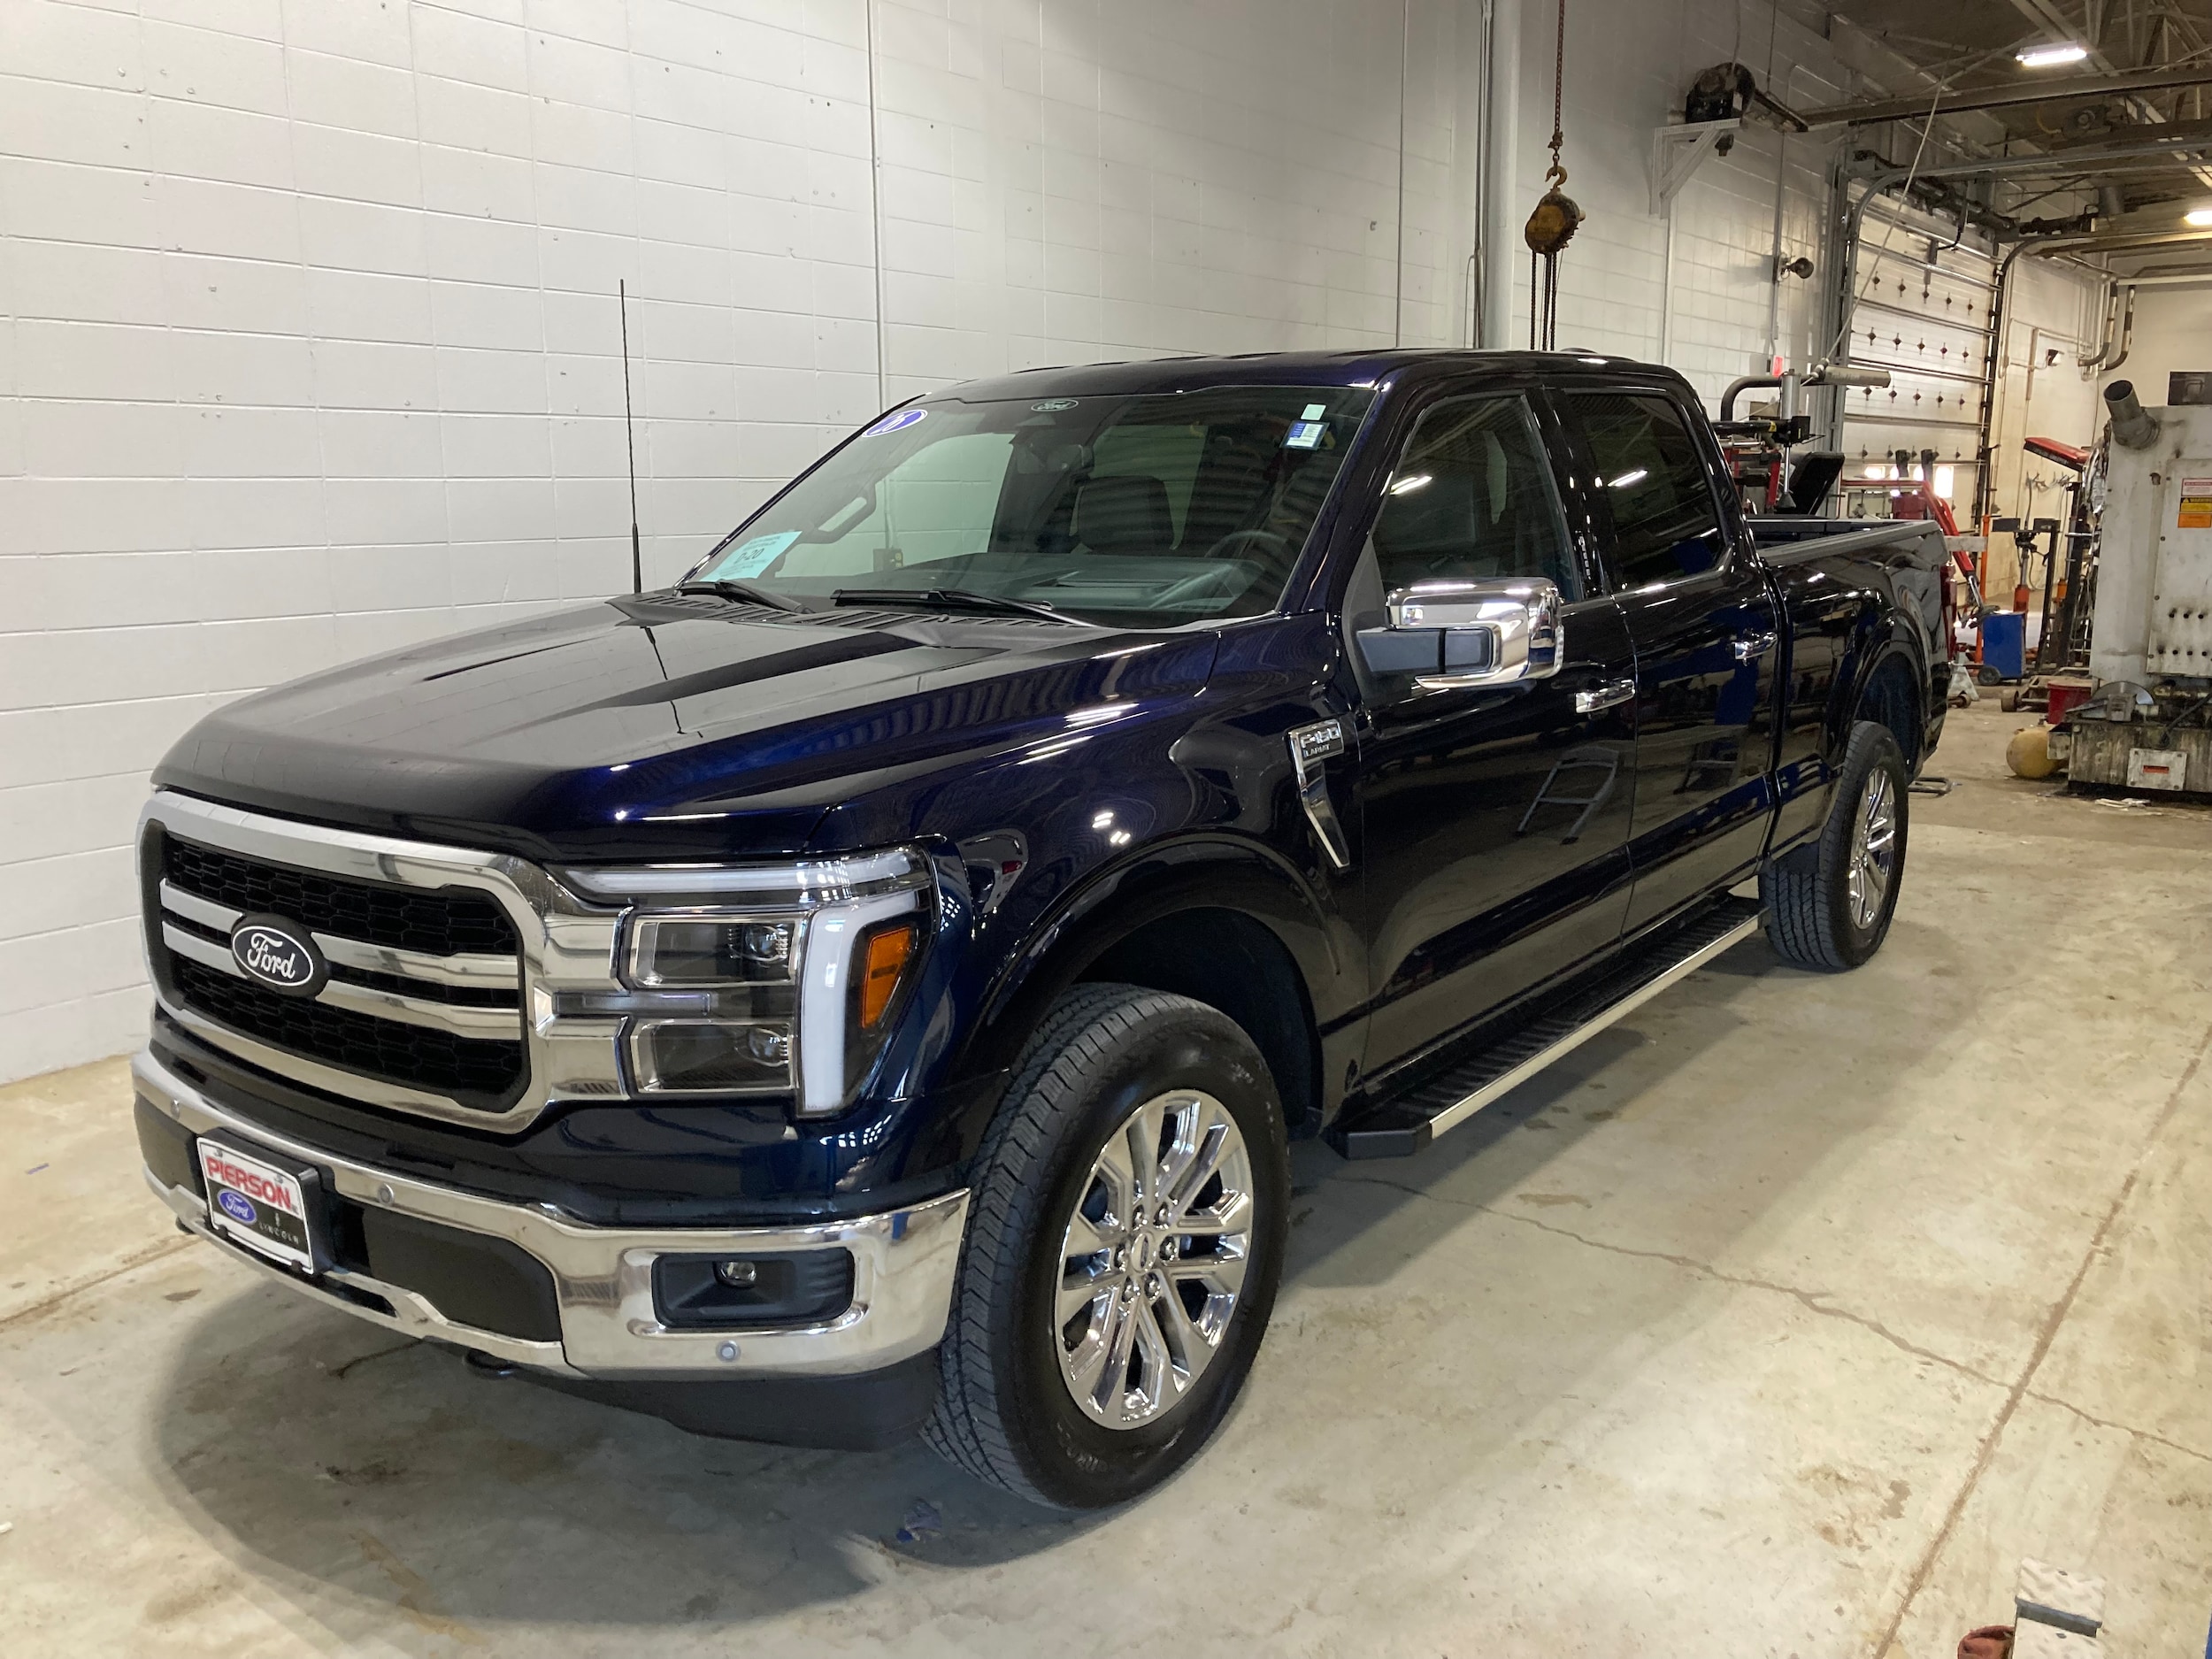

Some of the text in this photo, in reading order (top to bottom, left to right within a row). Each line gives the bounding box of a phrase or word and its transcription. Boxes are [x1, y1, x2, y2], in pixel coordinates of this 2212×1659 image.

[1300, 726, 1340, 749] F-150
[1303, 743, 1330, 757] LARIAT
[247, 932, 296, 979] Ford
[204, 1156, 292, 1210] PIERSON
[226, 1194, 250, 1219] Ford
[257, 1221, 300, 1245] LINCOLN
